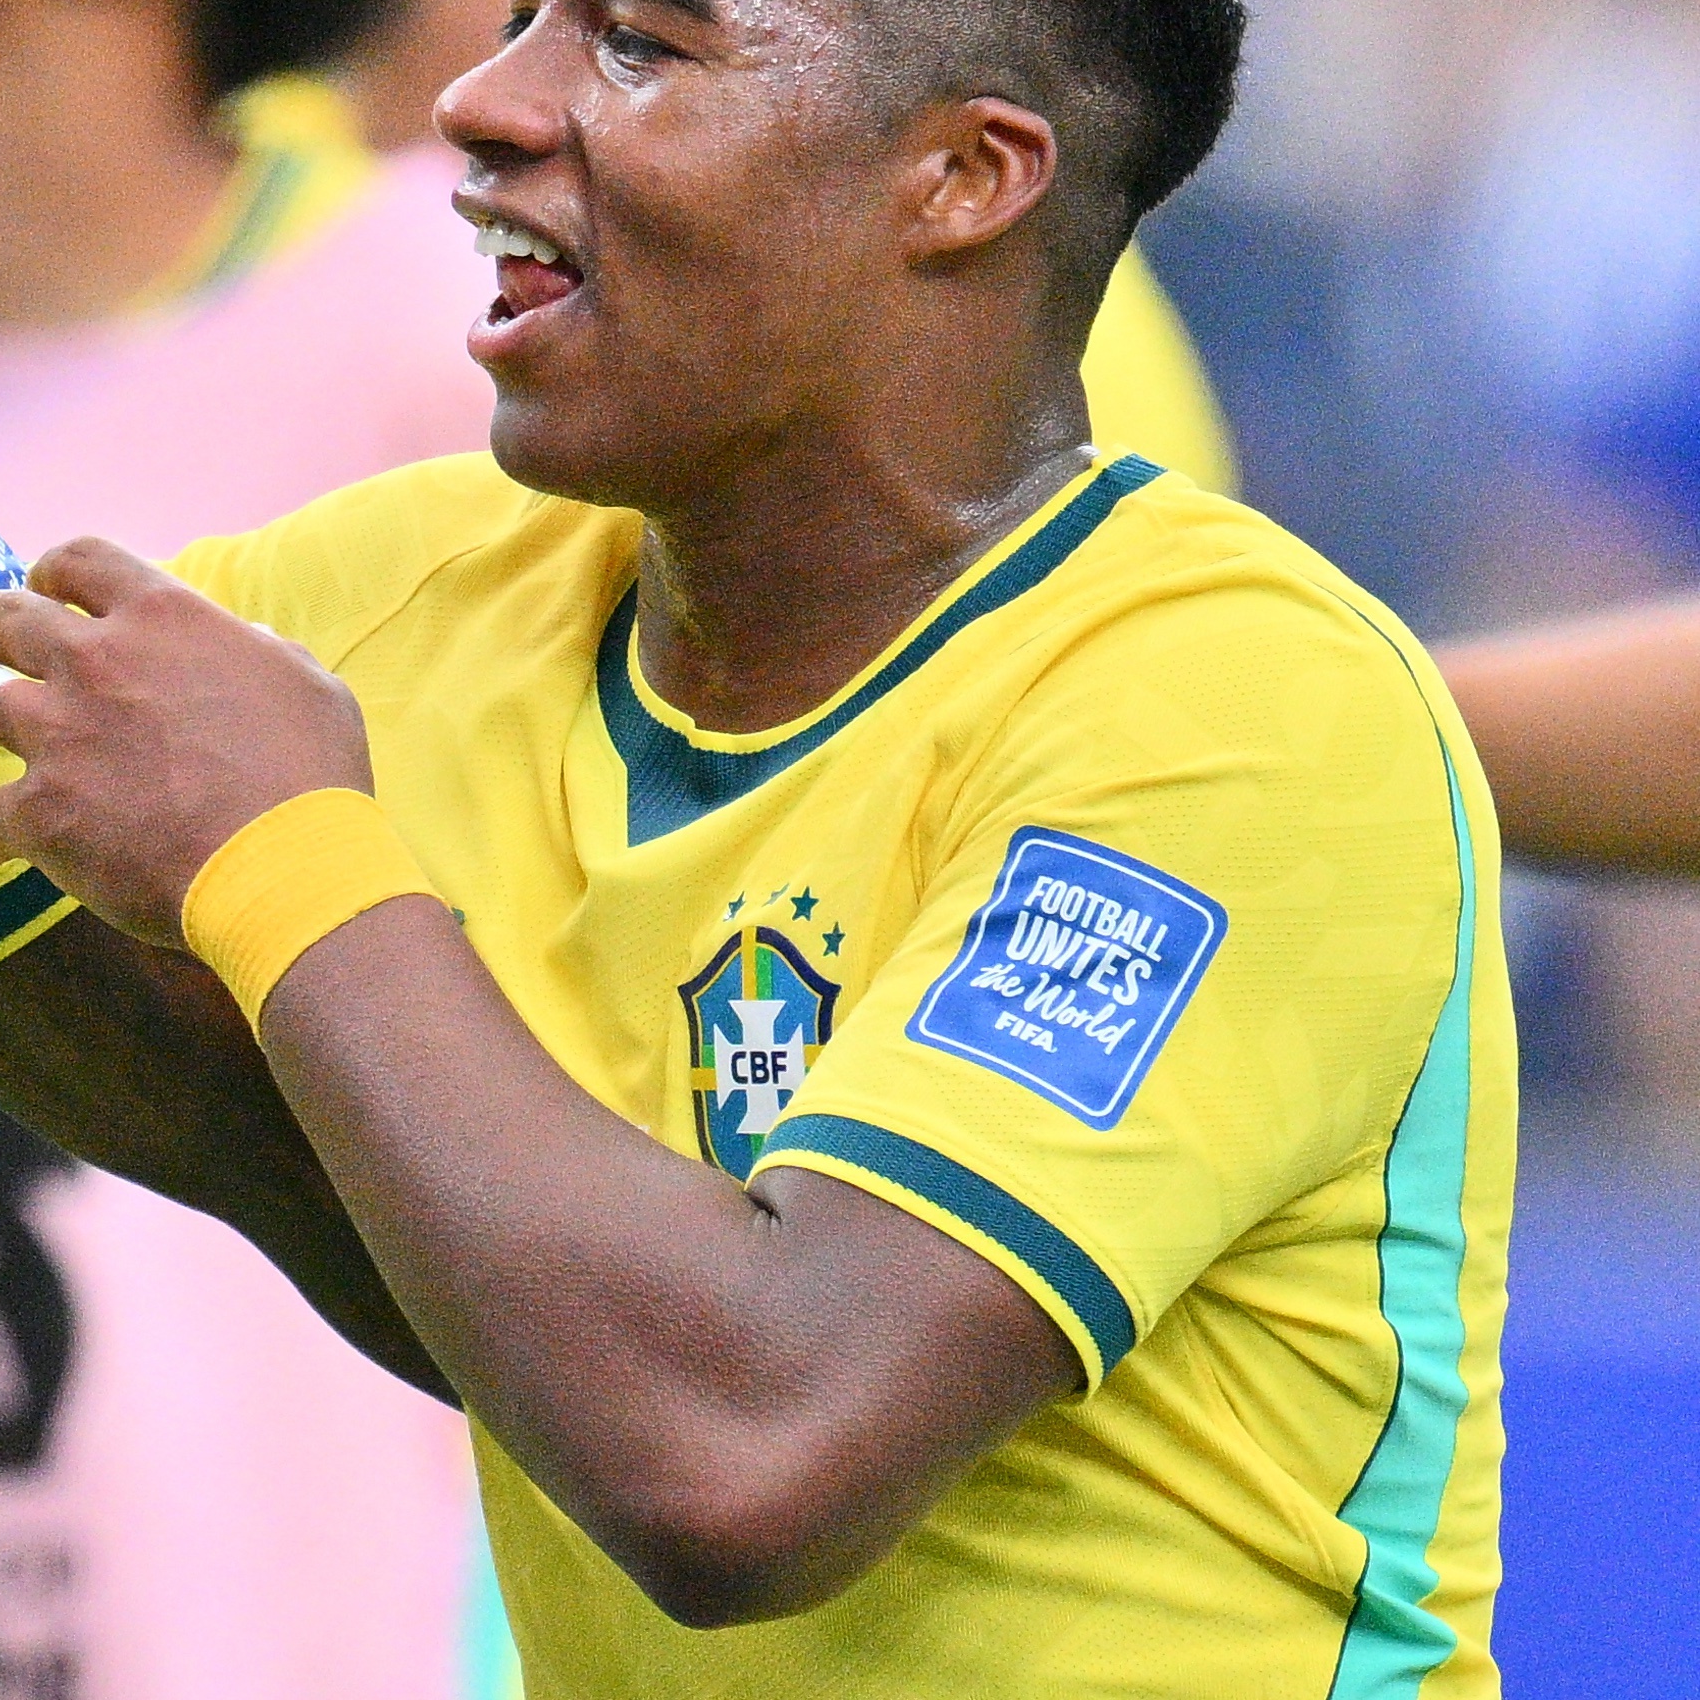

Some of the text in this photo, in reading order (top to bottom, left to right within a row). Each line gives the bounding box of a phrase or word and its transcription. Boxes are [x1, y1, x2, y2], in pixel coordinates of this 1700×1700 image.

[1006, 910, 1152, 1006] UNITES
[1023, 875, 1169, 962] FOOTBALL
[970, 963, 1137, 1055] the World
[995, 1011, 1054, 1052] FIFA
[731, 1051, 787, 1084] CBF
